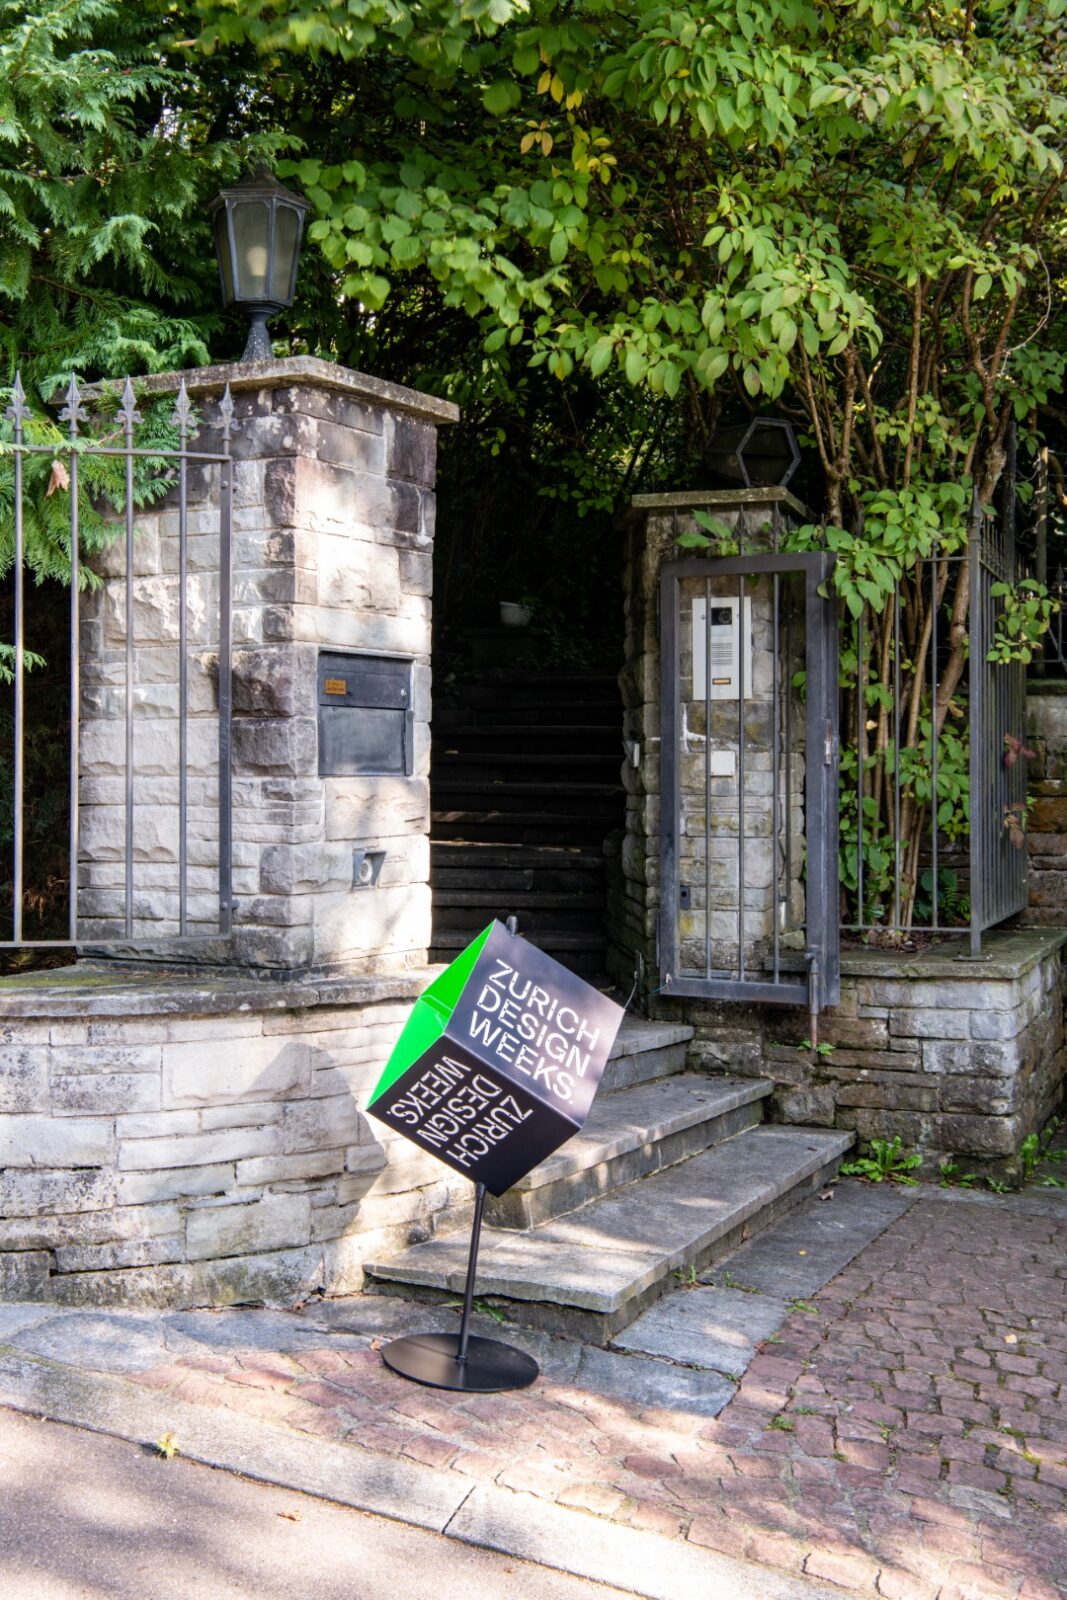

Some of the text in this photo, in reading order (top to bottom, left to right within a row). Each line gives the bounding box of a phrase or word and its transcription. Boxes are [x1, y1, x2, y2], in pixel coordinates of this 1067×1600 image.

[477, 984, 590, 1078] DESIGN
[488, 959, 601, 1050] ZURICH
[386, 1055, 472, 1125] WEEKS.
[469, 1011, 576, 1105] WEEKS.
[417, 1073, 503, 1148] DESIGN
[446, 1095, 534, 1168] ZURICH
